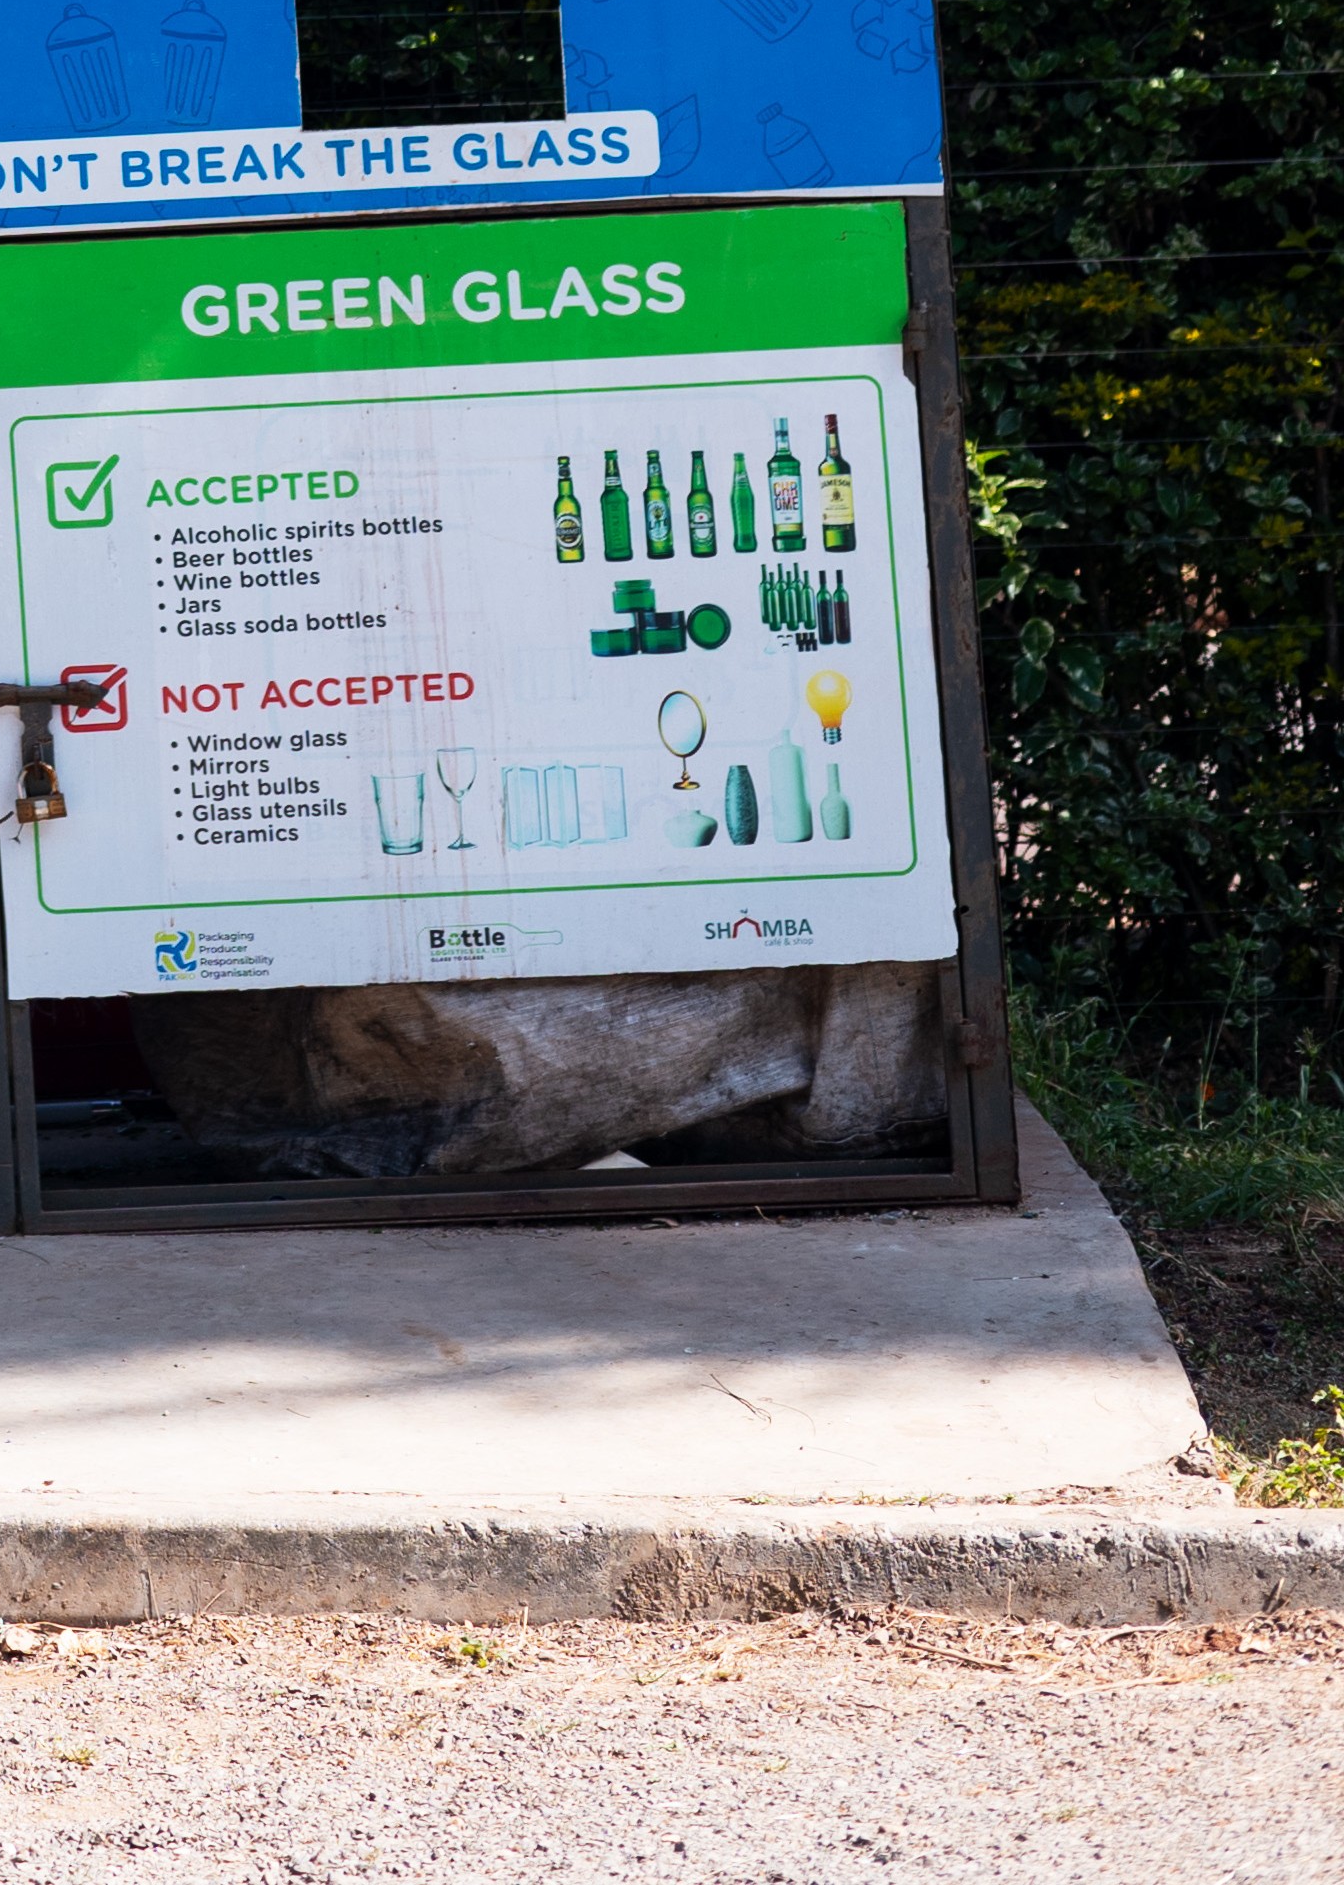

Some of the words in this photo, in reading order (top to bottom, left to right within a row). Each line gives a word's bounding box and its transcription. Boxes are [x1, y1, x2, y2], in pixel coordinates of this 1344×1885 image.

[121, 140, 305, 187] BREAK
[326, 133, 431, 176] THE
[452, 125, 631, 168] GLASS
[181, 275, 425, 337] GREEN
[452, 262, 685, 323] GLASS
[147, 470, 359, 508] ACCEPTED
[171, 524, 277, 546] Alcoholic
[285, 520, 355, 542] spirits
[363, 516, 442, 536] bottles
[173, 549, 224, 569] Beer
[232, 545, 313, 565] bottles
[174, 572, 231, 591] Wine
[240, 569, 320, 588] bottles
[175, 596, 222, 615] Jars
[176, 618, 236, 638] Glass
[244, 615, 298, 634] soda
[306, 611, 386, 632] bottles
[161, 681, 245, 714] NOT
[260, 672, 475, 709] ACCEPTED
[187, 732, 282, 752] Window
[289, 730, 348, 751] glass
[189, 757, 270, 776] Mirrors
[191, 781, 250, 801] Light
[258, 777, 320, 796] bulbs
[192, 803, 252, 823] Glass
[259, 799, 347, 819] utensils
[194, 826, 299, 845] Ceramics
[198, 931, 254, 944] Packaging
[705, 917, 813, 940] SHAMBA
[199, 943, 247, 954] Producer
[199, 954, 274, 968] Responsibility
[200, 968, 270, 980] Organisation
